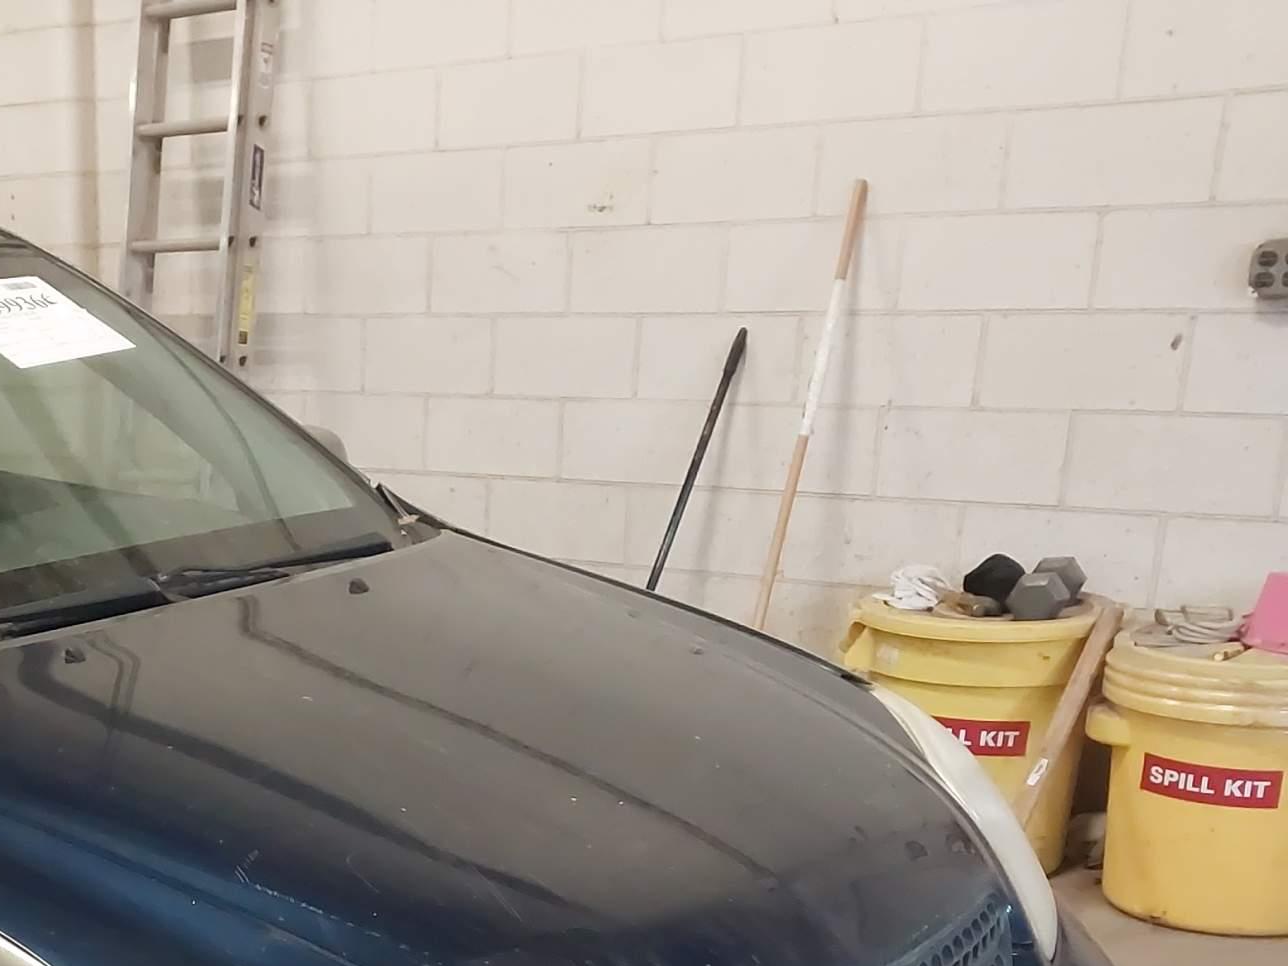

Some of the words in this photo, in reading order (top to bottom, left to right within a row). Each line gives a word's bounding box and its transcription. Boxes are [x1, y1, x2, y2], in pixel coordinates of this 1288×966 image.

[979, 730, 1020, 747] KIT
[1149, 766, 1215, 794] SPILL
[1223, 779, 1272, 798] KIT
